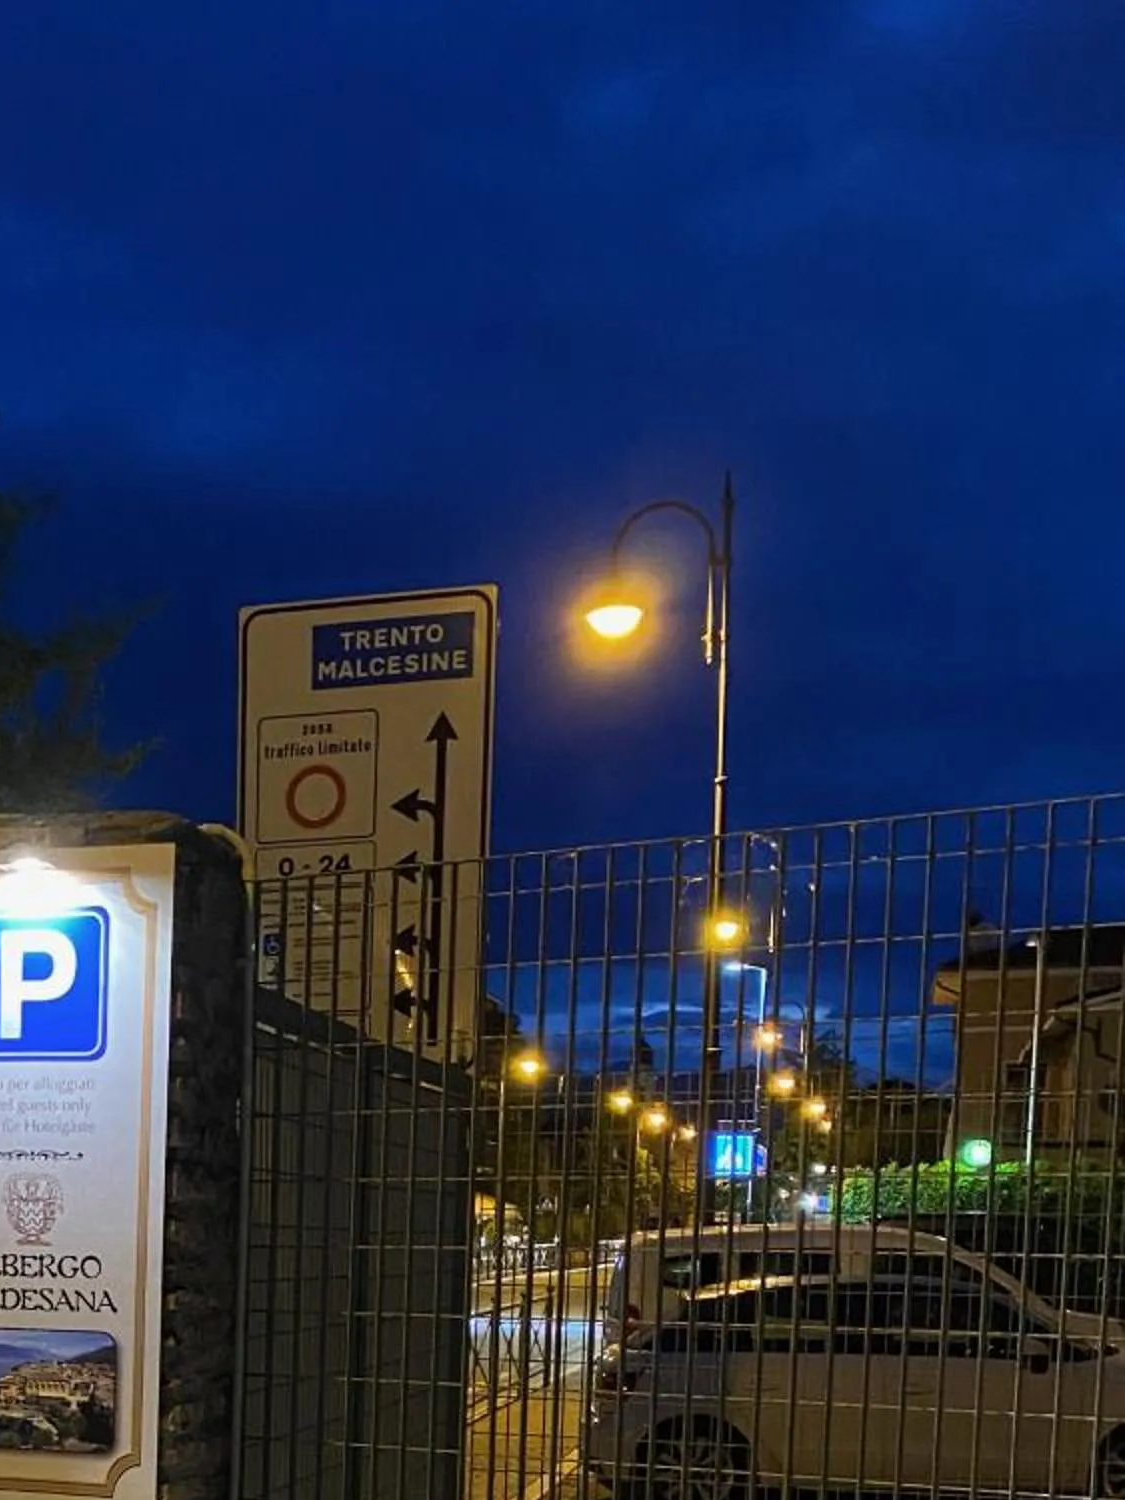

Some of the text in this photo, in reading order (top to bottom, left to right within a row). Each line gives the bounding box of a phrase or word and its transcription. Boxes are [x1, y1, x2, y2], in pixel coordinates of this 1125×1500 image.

[339, 623, 445, 651] TRENTO
[317, 649, 468, 681] MALCESINE
[263, 738, 373, 760] traffico limitato
[318, 853, 352, 874] 24
[61, 1097, 92, 1118] only
